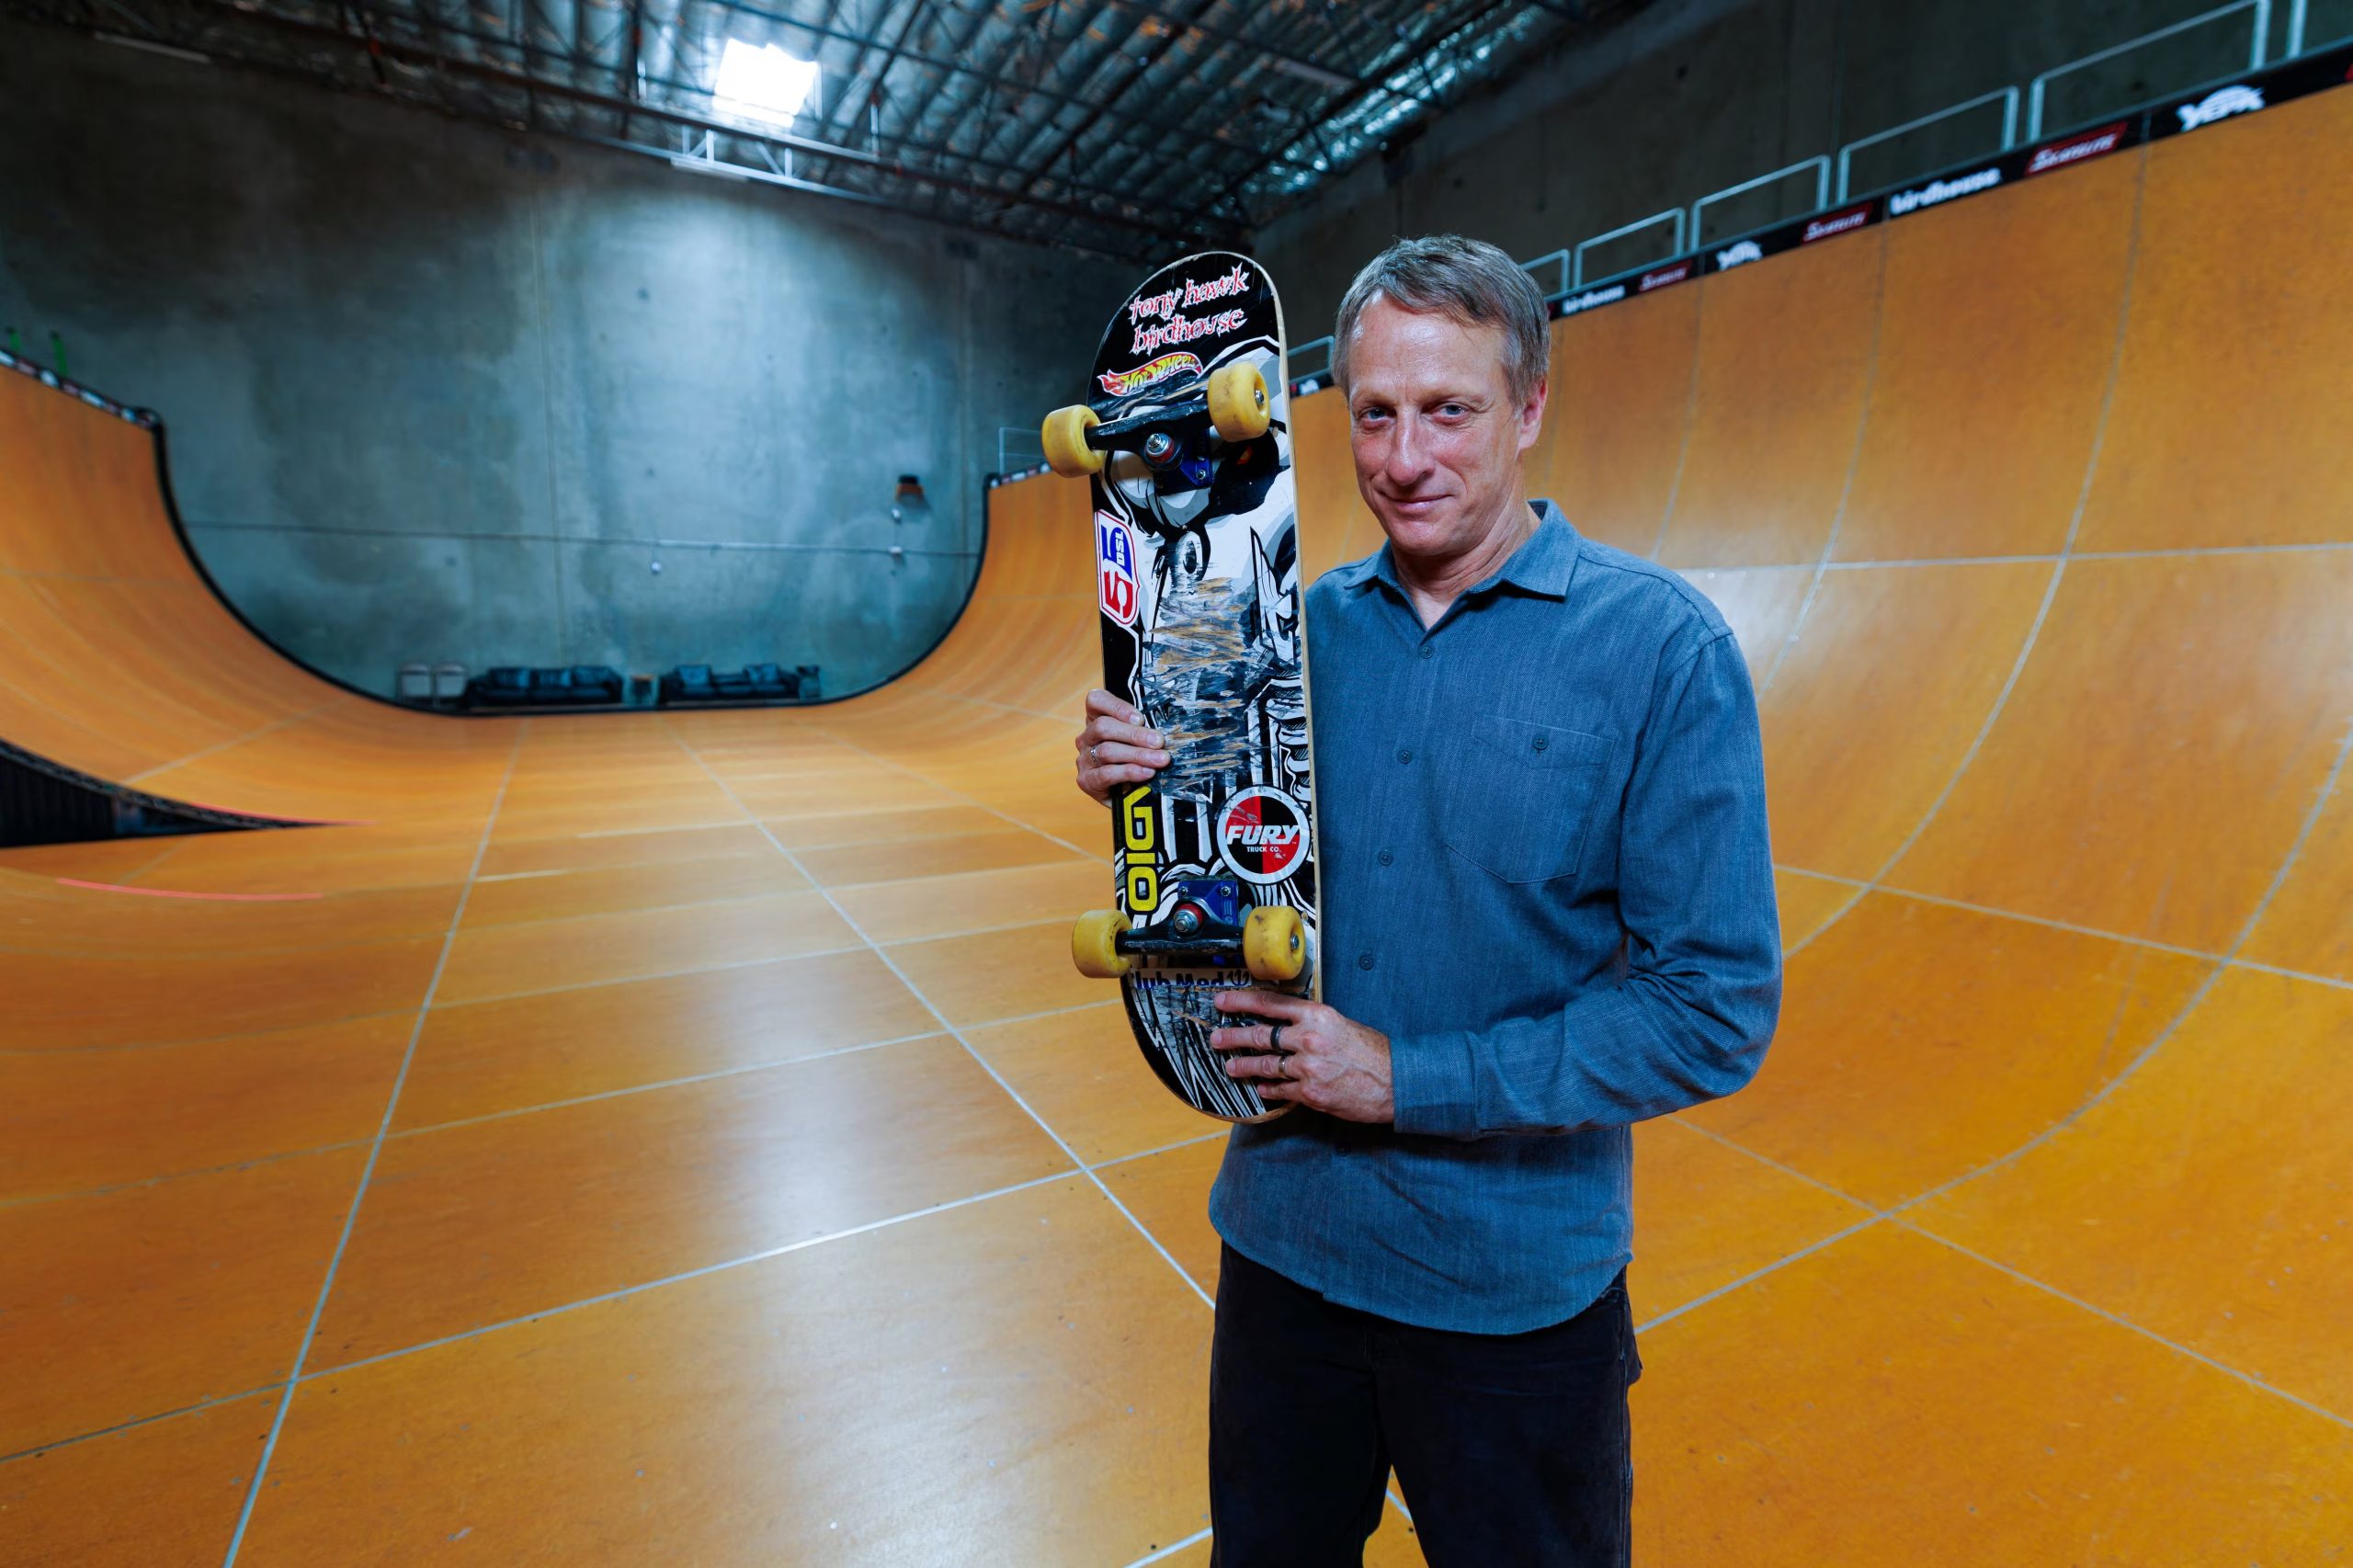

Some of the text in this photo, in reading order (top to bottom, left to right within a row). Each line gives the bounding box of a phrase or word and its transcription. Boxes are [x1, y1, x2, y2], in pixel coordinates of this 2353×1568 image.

[1128, 262, 1250, 325] tony hawk
[1129, 308, 1248, 357] birdhouse
[1226, 824, 1301, 846] FURY
[1246, 846, 1282, 854] TRUCK CO.
[1129, 971, 1224, 989] lub Med
